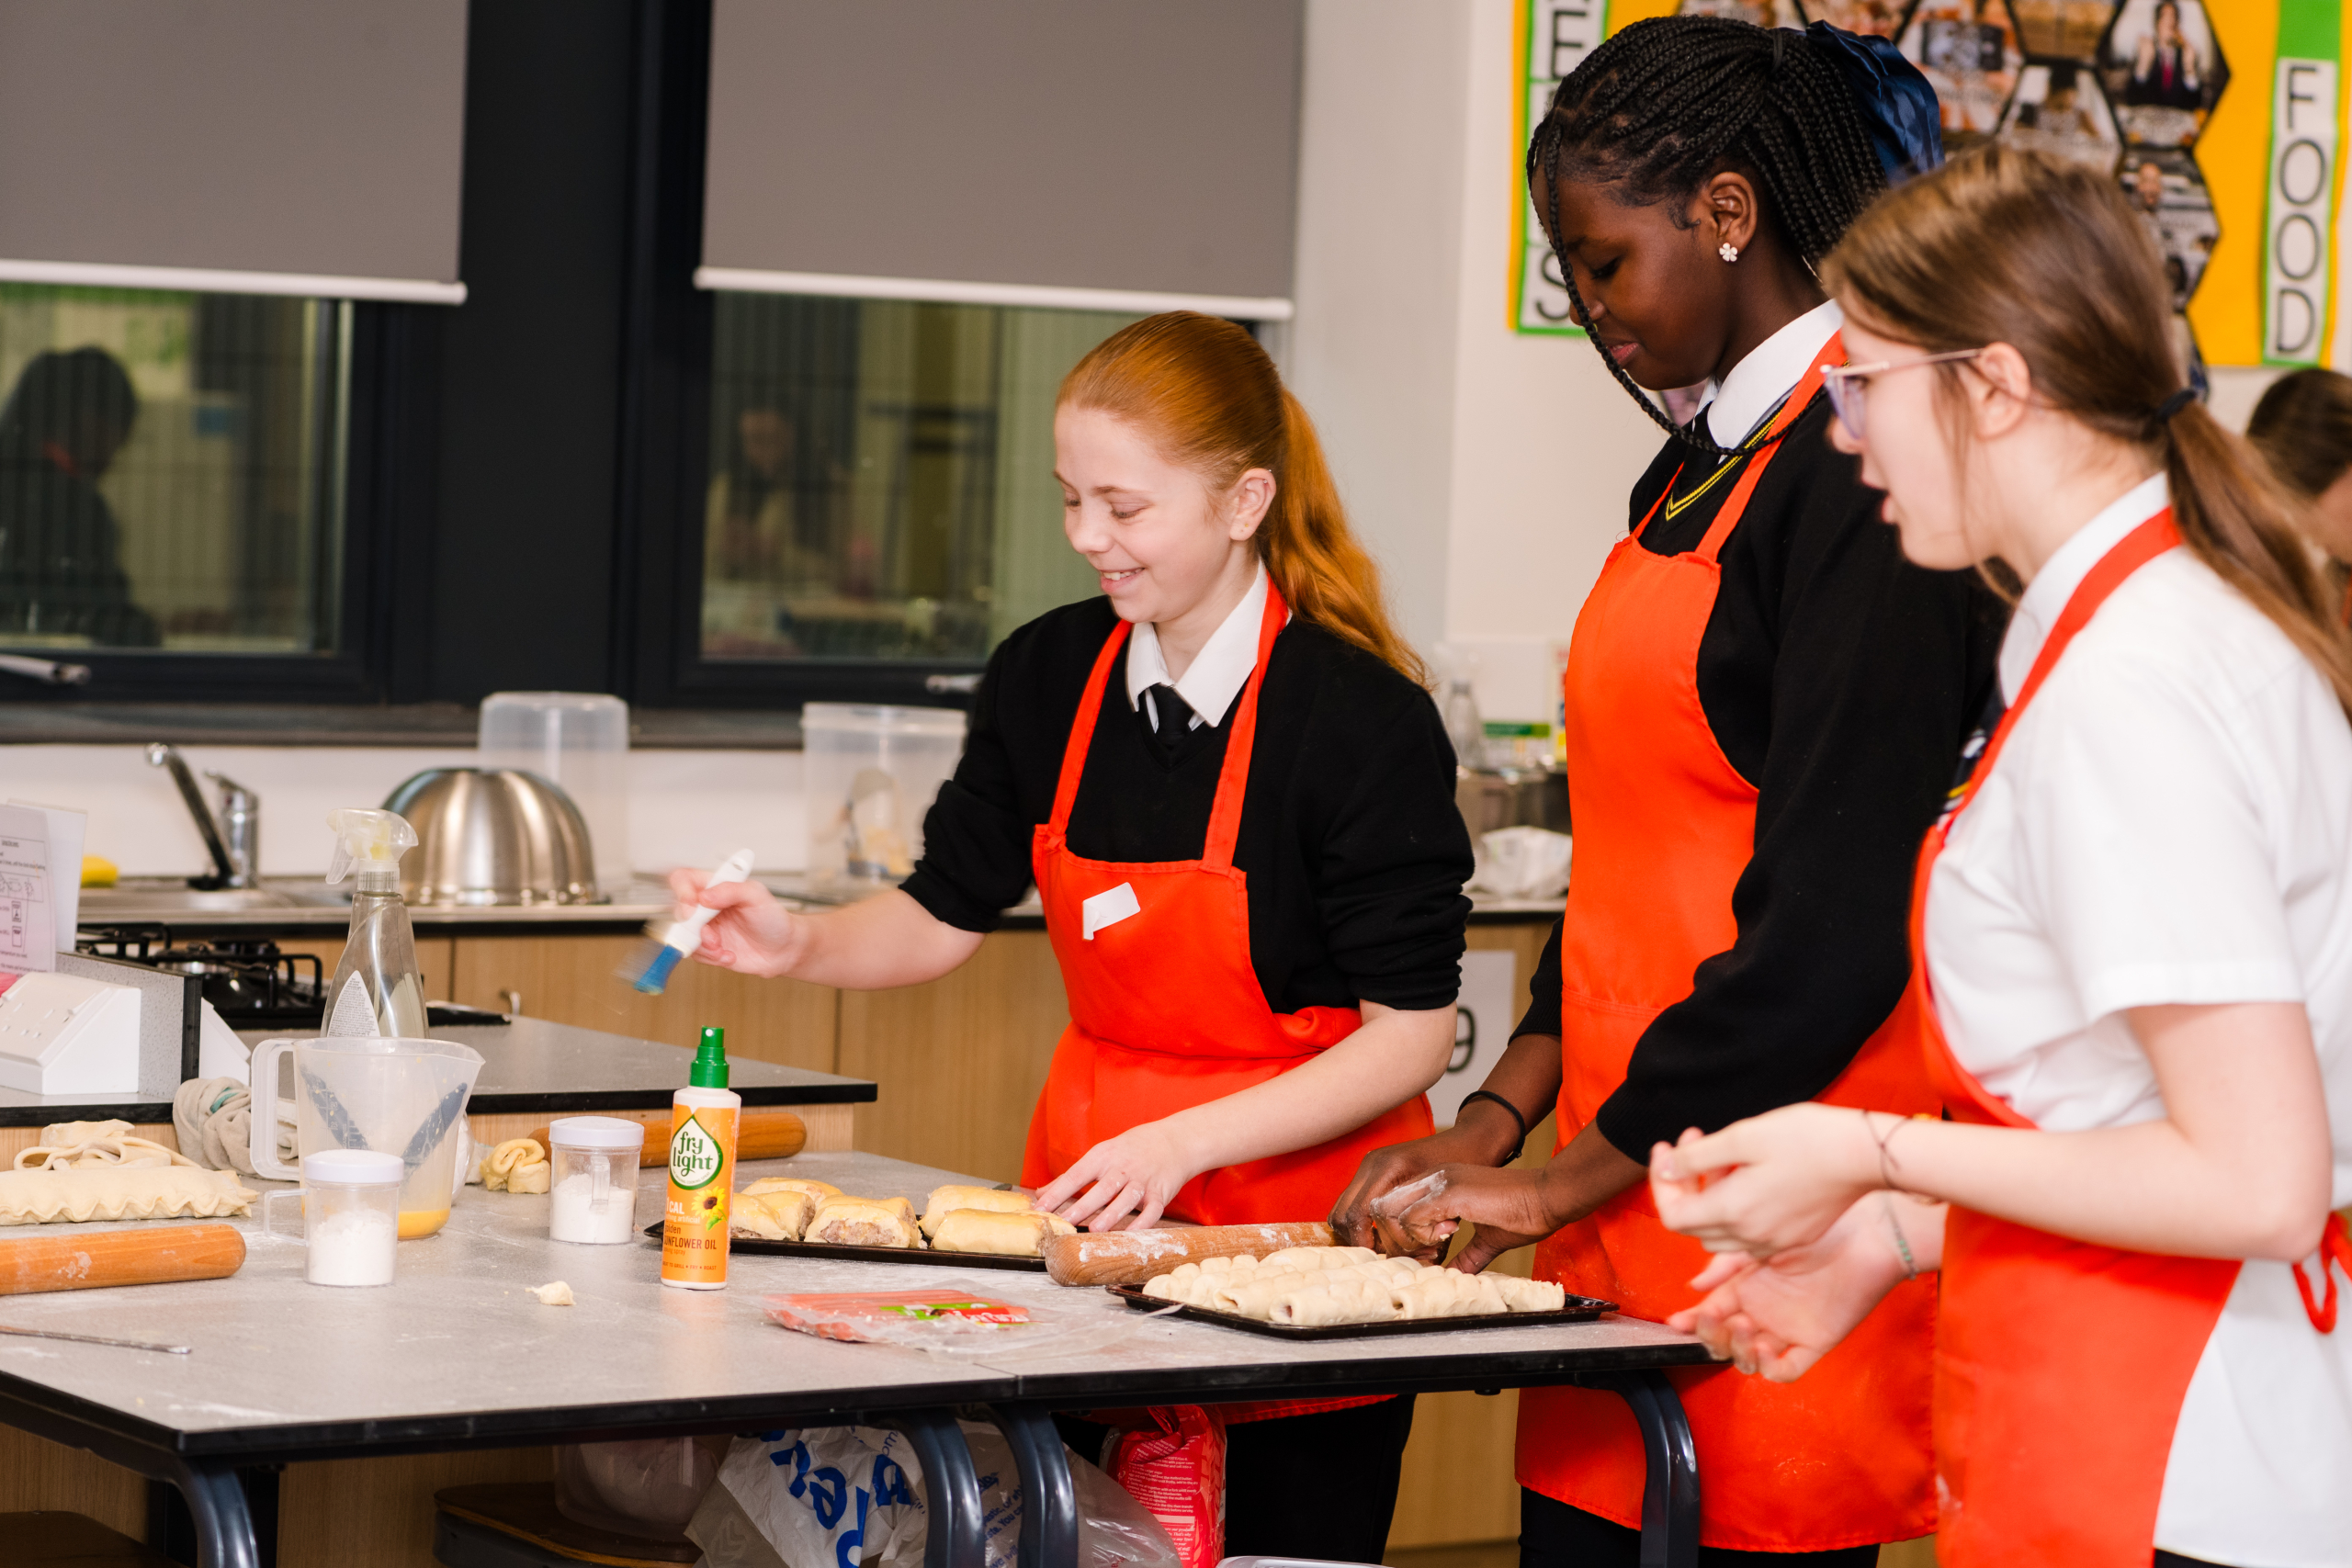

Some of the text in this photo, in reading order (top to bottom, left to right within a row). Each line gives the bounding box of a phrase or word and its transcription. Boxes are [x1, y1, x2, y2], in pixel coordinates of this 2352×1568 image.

[2276, 64, 2326, 355] FOOD
[678, 1132, 703, 1155] fry
[673, 1146, 714, 1177] light
[669, 1200, 685, 1215] CAL
[677, 1214, 701, 1224] artificial
[705, 1238, 718, 1250] OIL
[673, 1248, 686, 1257] spray
[998, 1513, 1016, 1527] You
